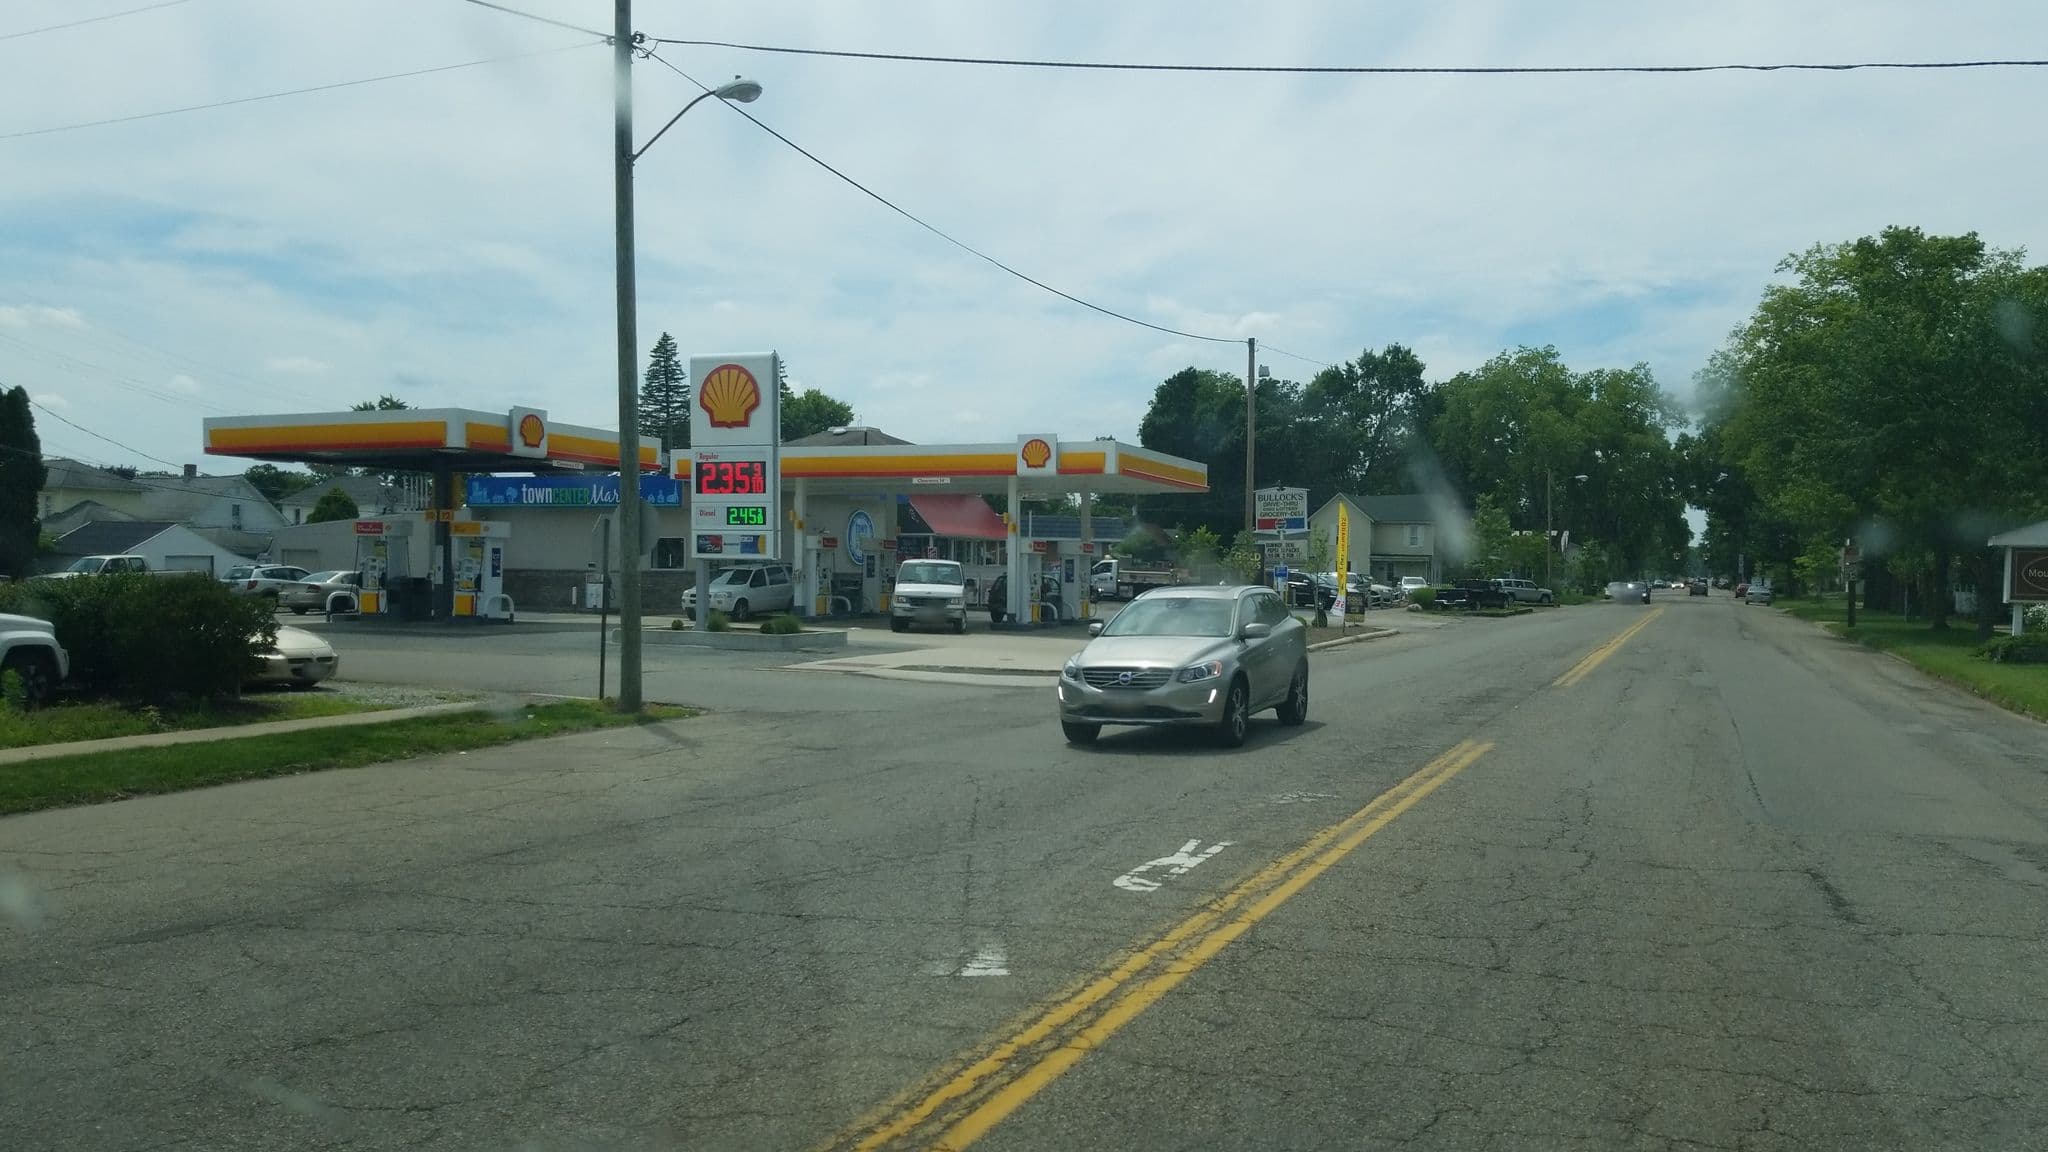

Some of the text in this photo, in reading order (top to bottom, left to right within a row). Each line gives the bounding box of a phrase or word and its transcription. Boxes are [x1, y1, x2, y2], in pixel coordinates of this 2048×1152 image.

[699, 453, 719, 461] Regular
[701, 462, 751, 494] 2.35
[699, 509, 716, 517] Diesel
